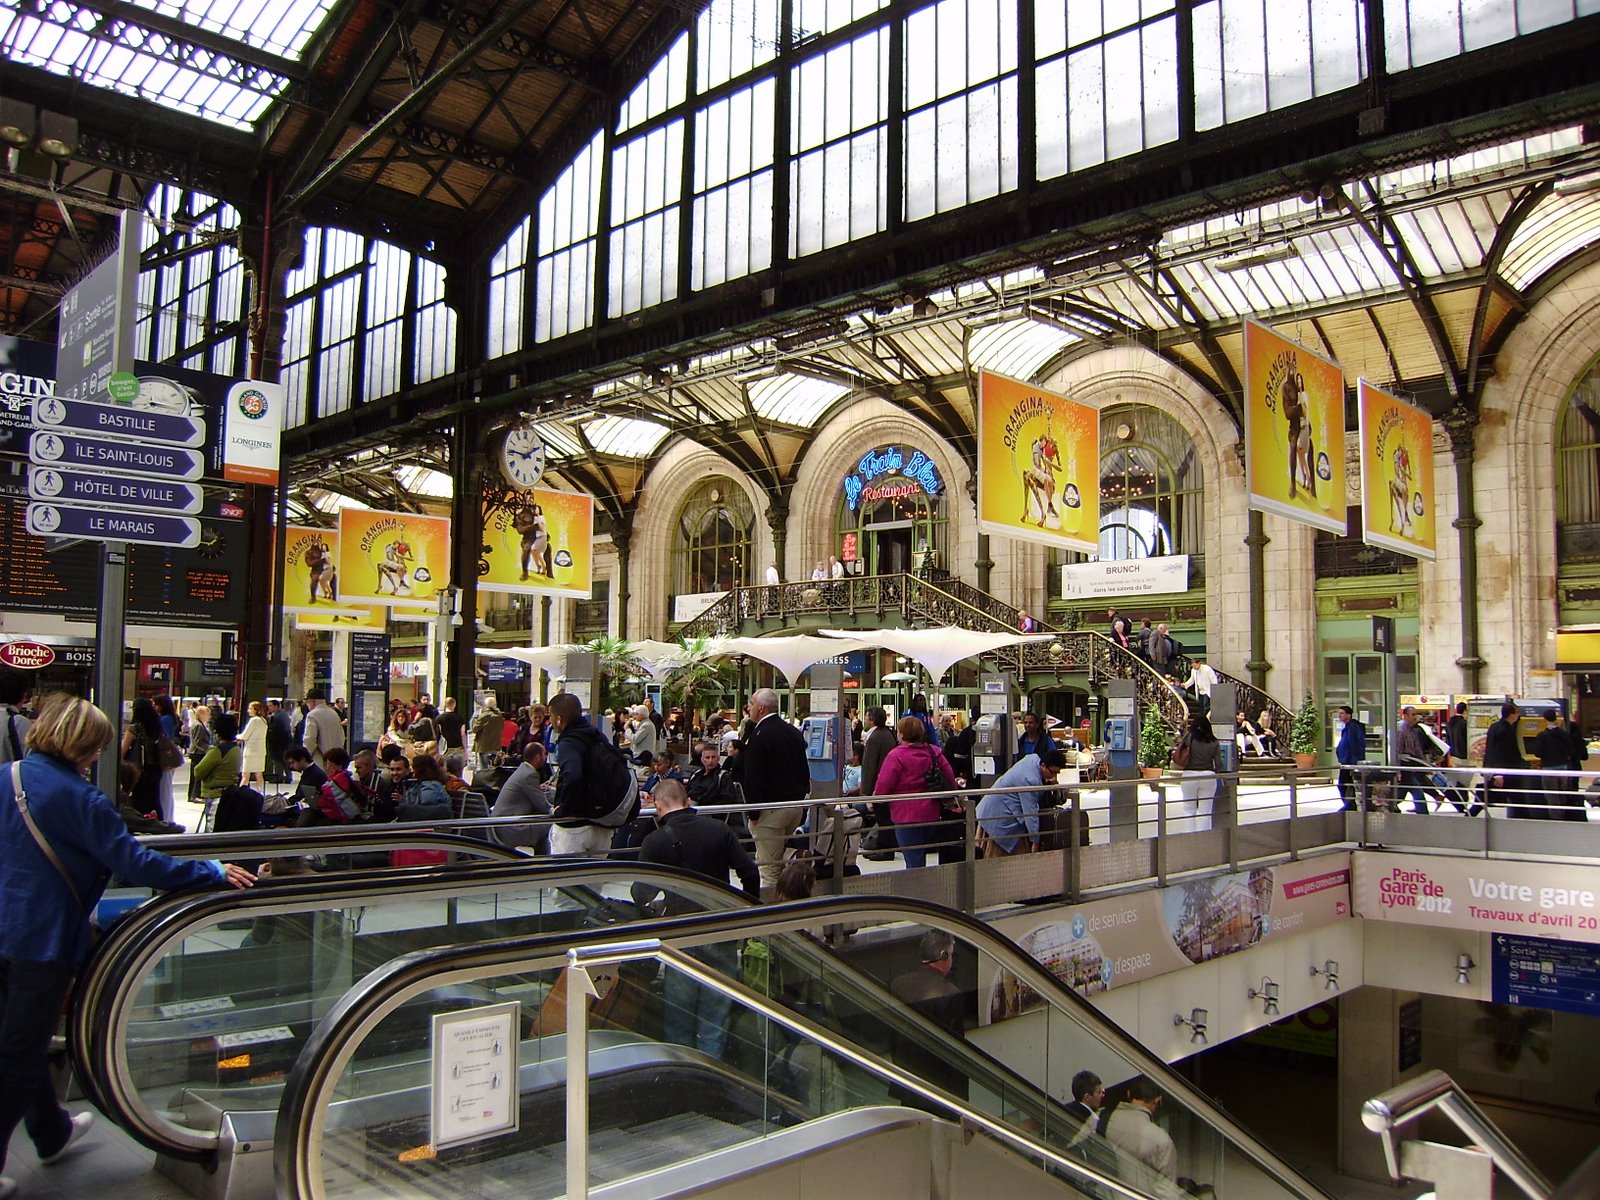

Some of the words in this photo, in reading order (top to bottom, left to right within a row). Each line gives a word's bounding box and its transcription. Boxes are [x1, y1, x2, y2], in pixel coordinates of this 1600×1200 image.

[0, 372, 57, 398] GIN
[1264, 350, 1297, 408] ORANGINA
[99, 412, 156, 432] BASTILLE
[1003, 396, 1043, 447] ORANGINA
[1011, 409, 1043, 453] NATURELLEMENT
[1375, 407, 1399, 458] ORANGINA
[231, 436, 273, 449] LONGINES
[75, 442, 95, 458] ÎLE
[98, 447, 174, 468] SAINT-LOUIS
[858, 447, 903, 480] Train
[903, 451, 939, 495] Bleu
[74, 479, 118, 496] HÔTEL
[120, 485, 138, 498] DE
[140, 487, 174, 502] VILLE
[862, 480, 921, 503] Restaurant
[90, 517, 105, 530] LE
[109, 519, 155, 534] MARAIS
[360, 517, 397, 552] ORANGINA
[286, 532, 323, 565] ORANGINA
[1105, 564, 1141, 575] BRUNCH
[8, 644, 50, 658] Brioche
[12, 655, 43, 666] Dorée
[1379, 876, 1419, 895] Gare
[1422, 879, 1444, 898] de
[1392, 867, 1427, 884] Paris
[1381, 892, 1416, 909] Lyon
[1416, 894, 1453, 914] 2012
[1468, 877, 1533, 903] Votre
[1538, 886, 1595, 909] gare
[1088, 914, 1101, 932] de
[1102, 907, 1138, 930] services
[1468, 905, 1524, 923] Travaux
[1528, 911, 1573, 928] d'avril
[1577, 915, 1600, 930] 20
[1510, 945, 1537, 957] Sortie
